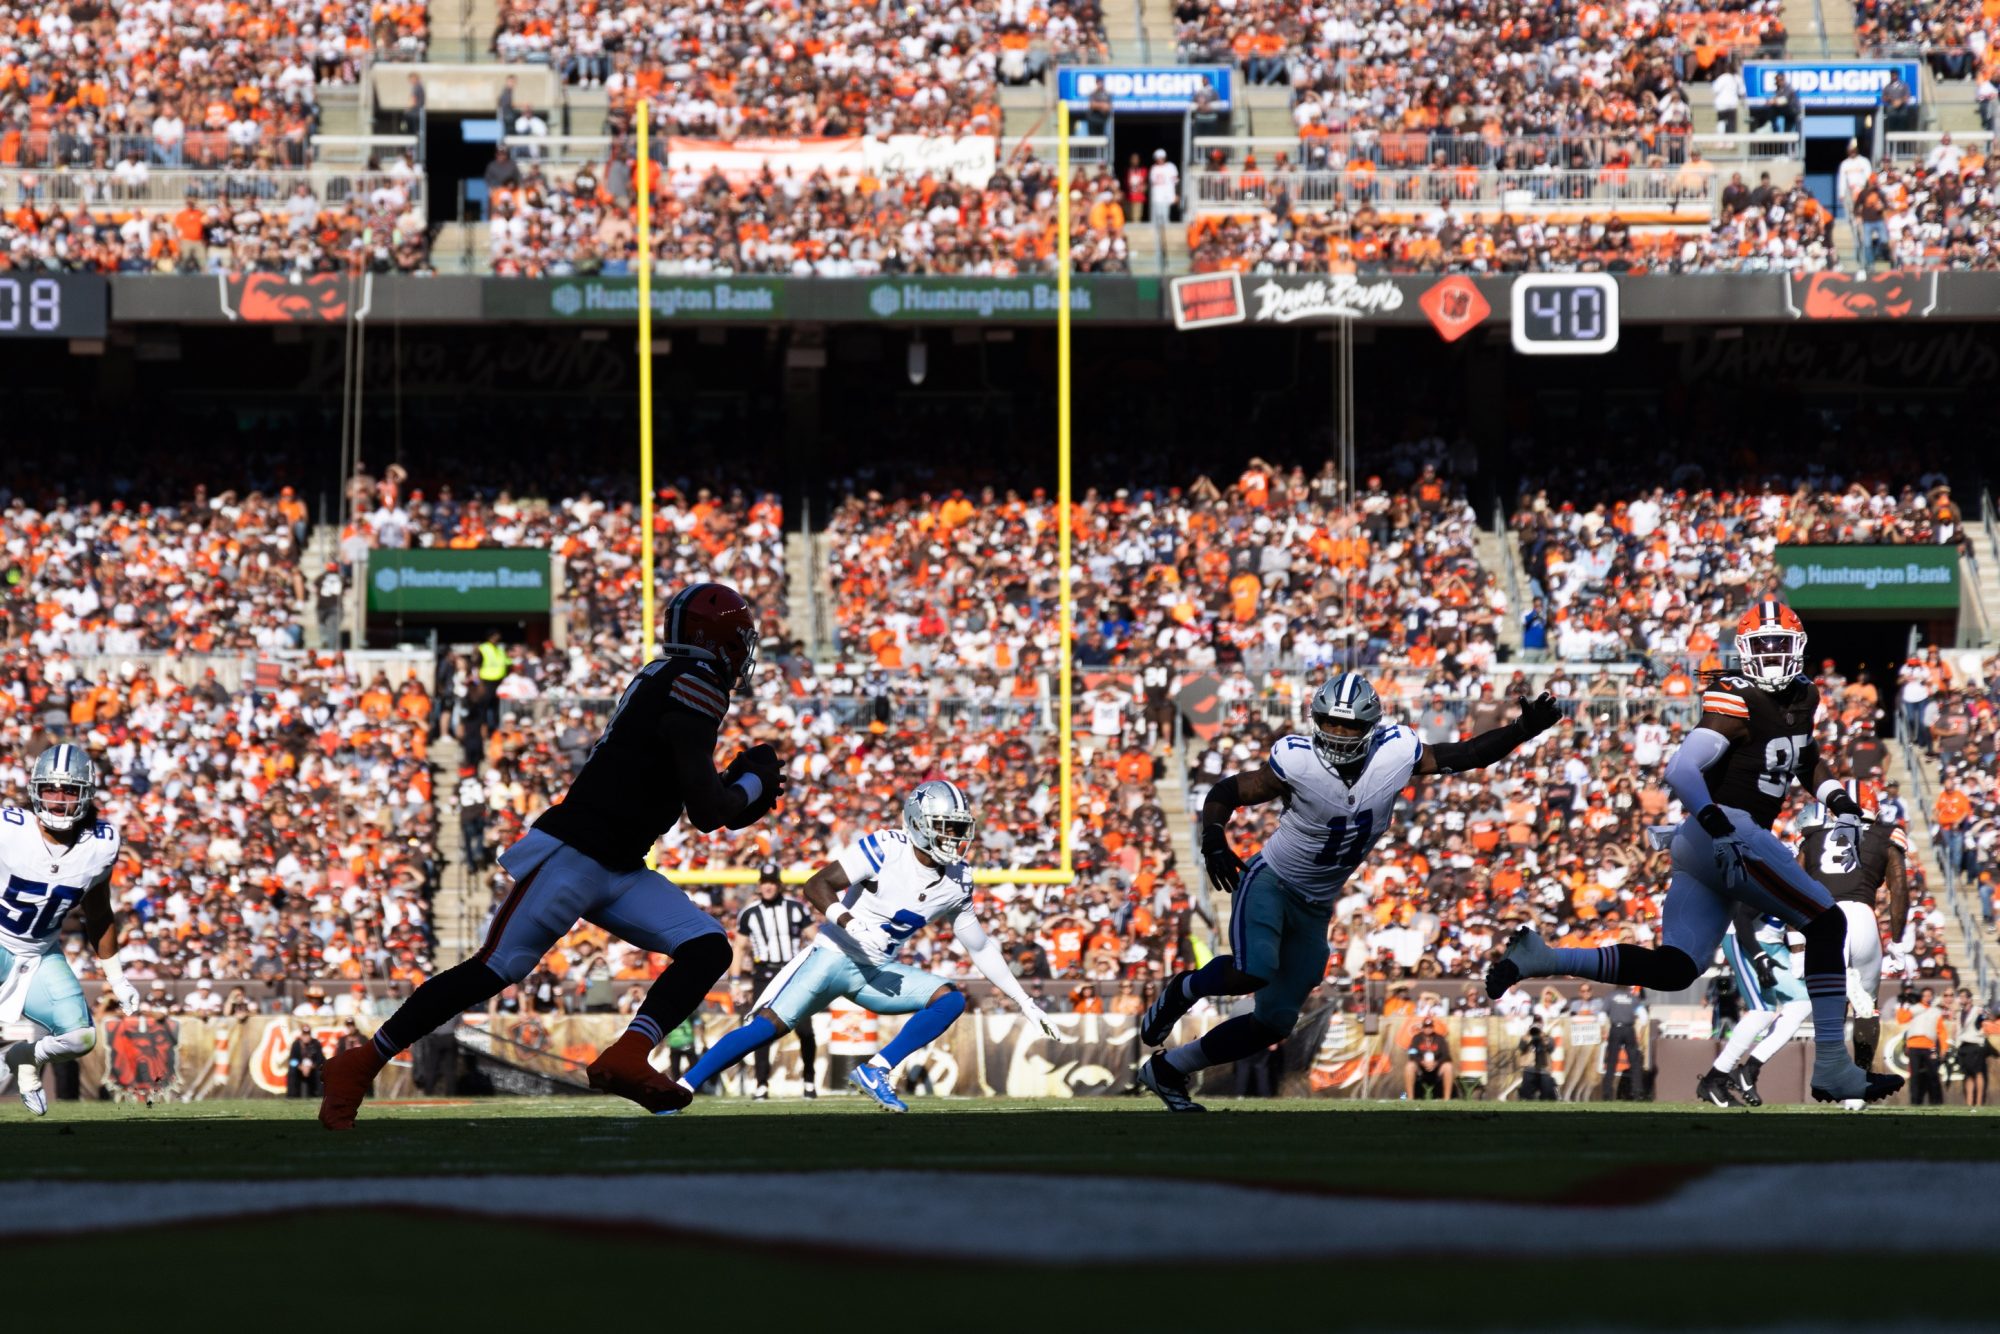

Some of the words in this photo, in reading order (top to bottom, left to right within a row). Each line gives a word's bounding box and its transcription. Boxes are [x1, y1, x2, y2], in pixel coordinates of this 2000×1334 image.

[1133, 74, 1204, 96] LIGHT
[1819, 70, 1891, 92] LIGHT
[0, 278, 60, 331] 08
[584, 283, 712, 316] Huntgton
[715, 283, 773, 311] Bank
[903, 283, 1029, 316] Huntington
[1531, 288, 1600, 339] 40
[400, 567, 496, 594] Huntington
[497, 566, 542, 588] Bank
[1807, 564, 1905, 590] Huntington
[1906, 563, 1951, 584] Bank
[1314, 808, 1374, 867] 11
[0, 874, 86, 940] 50
